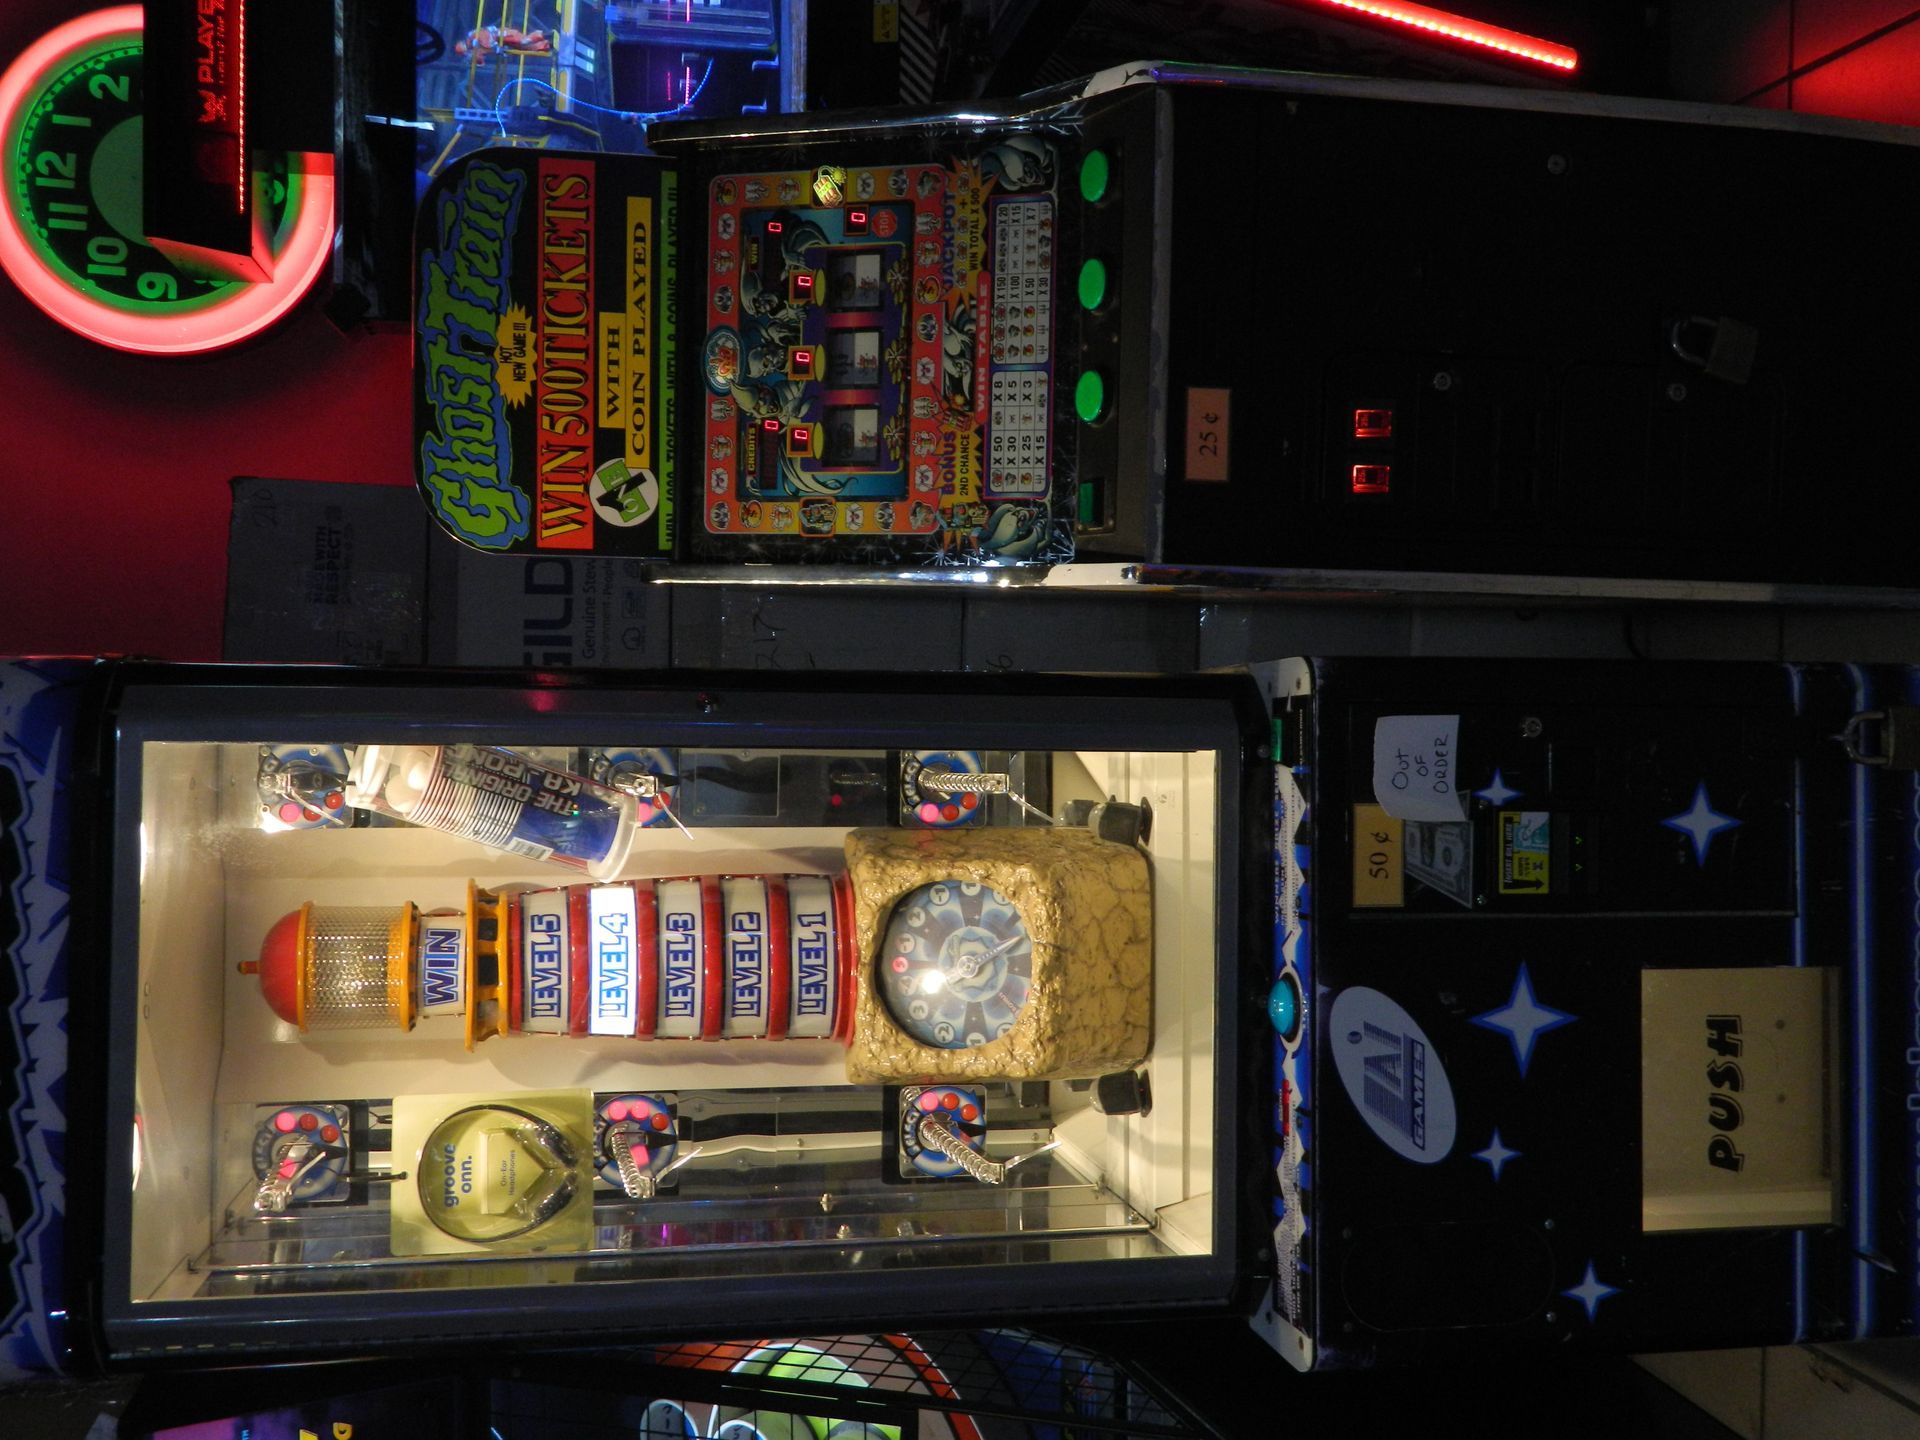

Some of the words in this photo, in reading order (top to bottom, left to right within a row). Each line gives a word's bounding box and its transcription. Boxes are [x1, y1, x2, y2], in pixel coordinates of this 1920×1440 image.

[88, 73, 130, 102] 2
[51, 113, 92, 128] 1
[35, 151, 76, 190] 12
[970, 187, 981, 206] 500
[47, 201, 89, 231] 11
[850, 212, 867, 224] 0
[999, 206, 1008, 217] 20
[1012, 205, 1021, 216] 15
[766, 221, 783, 233] 0
[879, 211, 890, 235] STOP
[969, 217, 980, 248] TOTAL
[943, 191, 956, 290] JACKPOT
[86, 236, 128, 277] 10
[425, 163, 519, 342] Train
[750, 242, 759, 264] WIN
[969, 250, 979, 271] WIN
[136, 271, 178, 300] 9
[631, 221, 648, 357] PLAYED
[797, 275, 812, 286] 0
[997, 277, 1007, 291] 150
[1010, 276, 1020, 290] 100
[1026, 278, 1035, 288] 50
[1039, 277, 1048, 288] 30
[979, 283, 988, 359] TABLE
[500, 346, 512, 364] HOT
[795, 351, 811, 362] 0
[513, 360, 527, 382] NEW
[606, 326, 620, 419] WITH
[977, 367, 985, 412] WIN
[994, 380, 1003, 389] 8
[1008, 380, 1017, 388] 5
[1023, 380, 1032, 388] 3
[994, 393, 1003, 401] X
[1008, 393, 1017, 401] X
[1023, 393, 1032, 401] X
[631, 370, 647, 455] COIN
[427, 333, 522, 537] Ghost
[763, 420, 780, 430] 0
[793, 429, 808, 440] 0
[748, 427, 757, 472] CREDITS
[959, 433, 971, 474] CHANCE
[993, 436, 1003, 452] 50
[1008, 436, 1016, 452] 30
[1022, 435, 1031, 451] 25
[1036, 435, 1045, 450] 15
[1199, 431, 1217, 457] 25
[942, 431, 956, 495] BONUS
[993, 457, 1002, 465] X
[1007, 457, 1016, 465] X
[1022, 456, 1031, 465] X
[1035, 456, 1044, 465] X
[541, 440, 590, 539] WIN
[959, 476, 969, 496] 2ND
[315, 525, 327, 561] WITH
[327, 525, 341, 604] RESPECT
[582, 598, 597, 659] Genuine
[1415, 754, 1429, 777] OF
[1433, 733, 1449, 794] ORDER
[443, 759, 532, 802] ORIGINAL
[532, 790, 574, 816] THE
[1369, 852, 1389, 879] 50
[531, 914, 561, 933] 5
[599, 913, 628, 934] 4
[666, 912, 695, 932] 3
[732, 912, 761, 932] 2
[797, 911, 827, 927] 1
[423, 928, 460, 1006] WIN
[531, 935, 561, 1018] LEVEL
[599, 935, 628, 1018] LEVEL
[665, 933, 695, 1018] LEVEL
[732, 934, 761, 1017] LEVEL
[797, 931, 827, 1016] LEVEL
[1412, 1038, 1425, 1150] GAMES
[1706, 1014, 1744, 1172] PUSH
[442, 1143, 459, 1207] groove
[461, 1155, 472, 1194] onn.
[509, 1150, 517, 1196] Headphones
